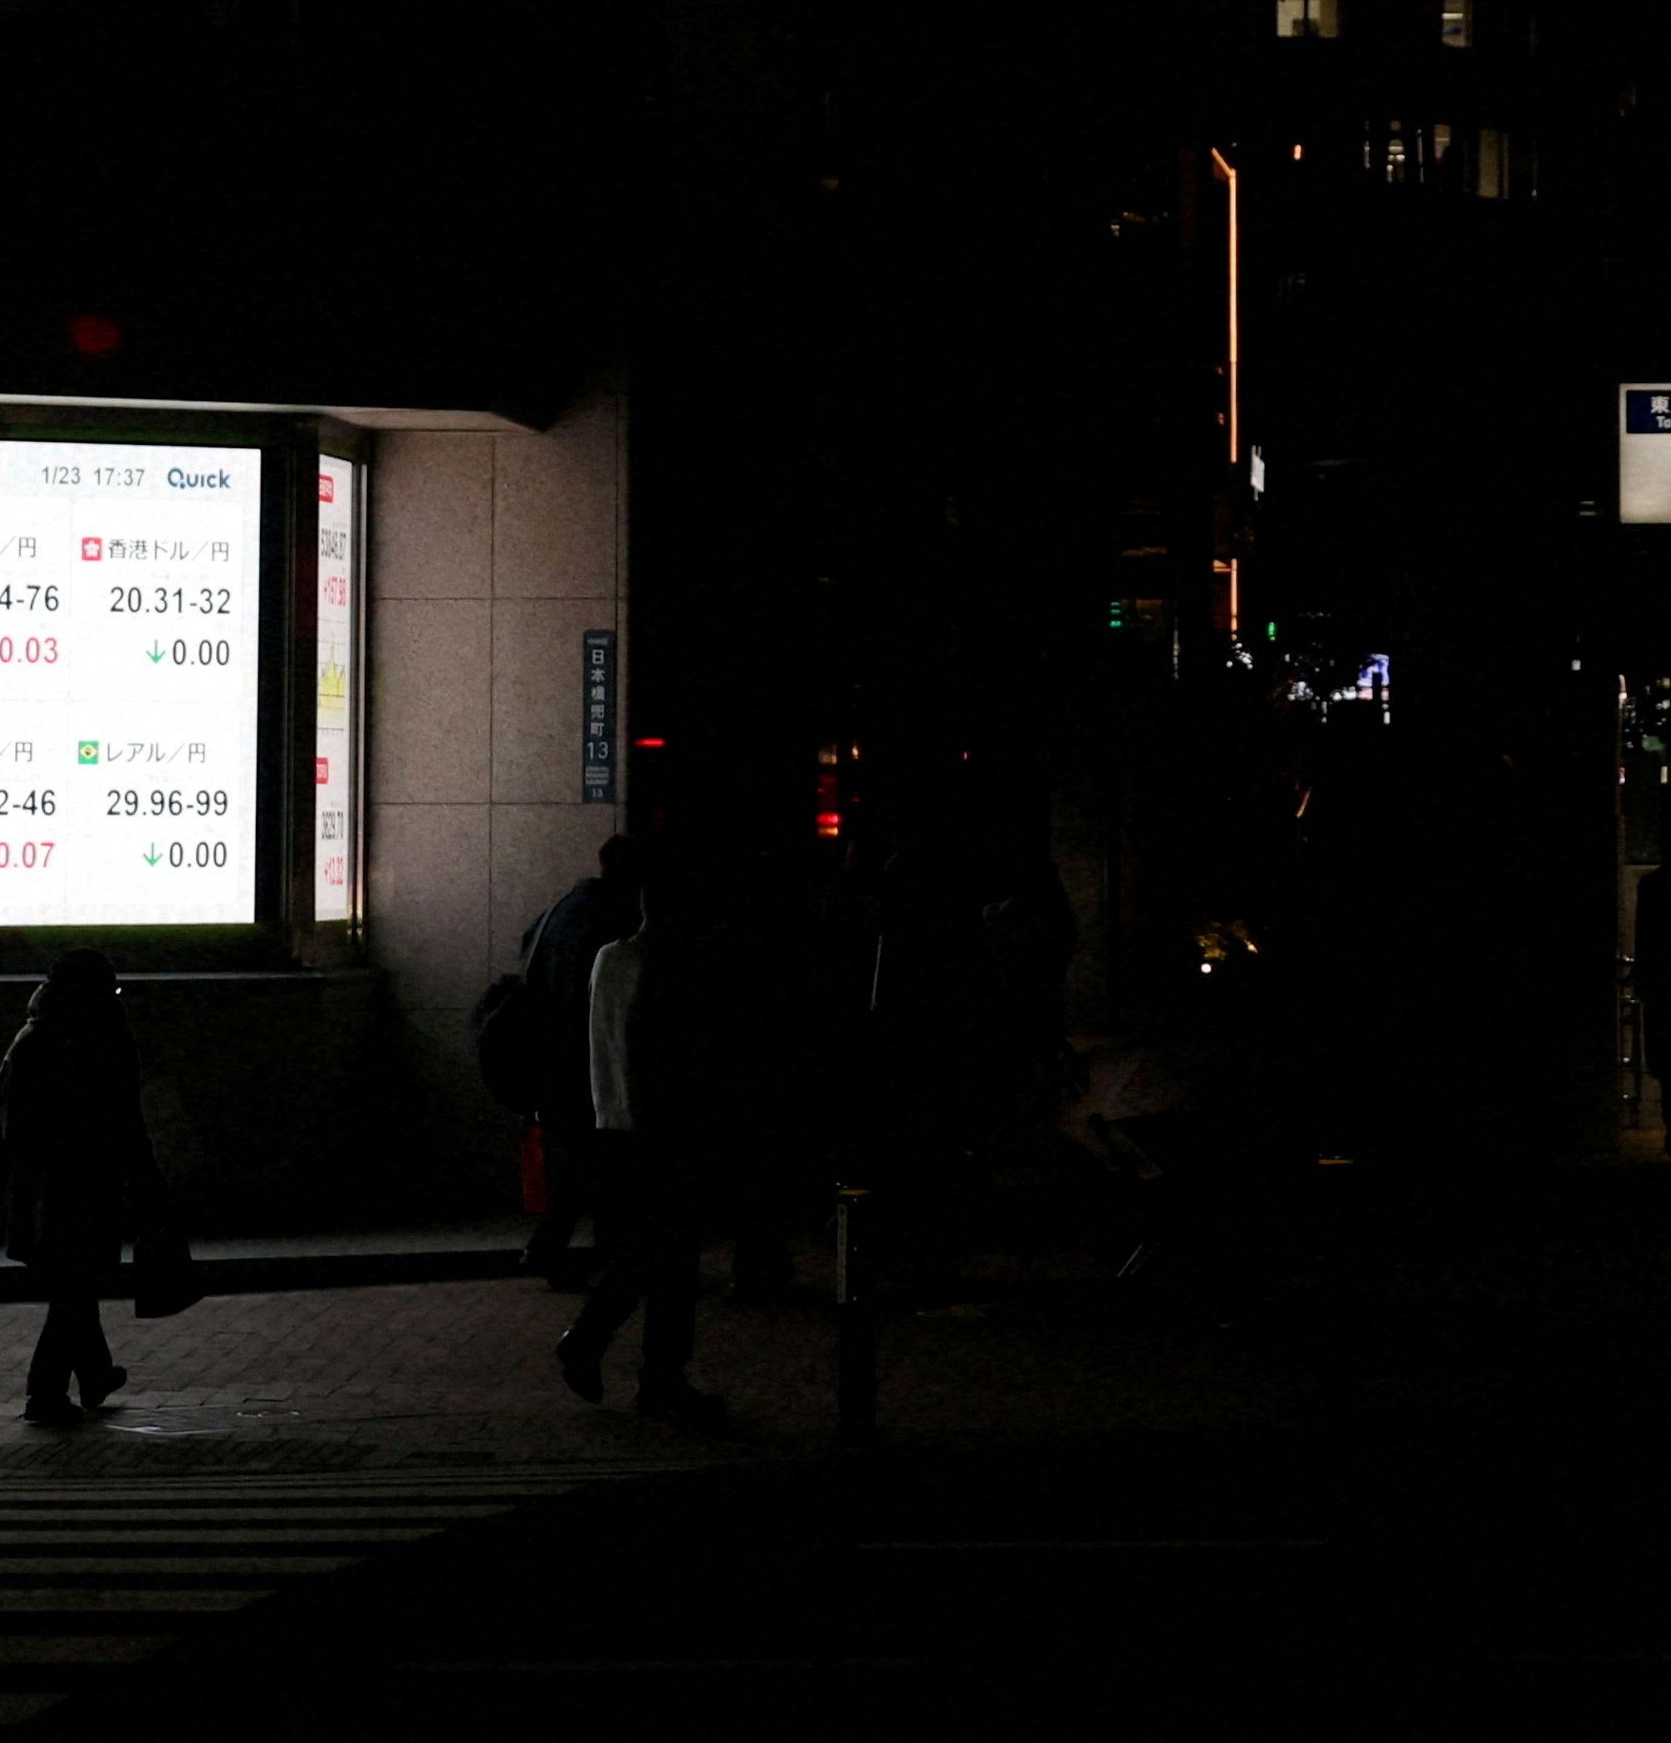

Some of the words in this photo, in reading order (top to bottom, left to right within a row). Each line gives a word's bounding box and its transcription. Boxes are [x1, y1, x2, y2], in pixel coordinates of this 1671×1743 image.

[42, 466, 81, 485] 1/23
[94, 468, 145, 486] 17:37
[167, 467, 230, 489] Quick
[109, 539, 229, 562] 香港ドル／円
[110, 587, 230, 614] 20.31-32
[173, 639, 229, 666] 0.00
[107, 743, 205, 763] レアル／円
[587, 742, 609, 759] 13
[107, 790, 228, 816] 29.96-99
[169, 842, 227, 867] 0.00
